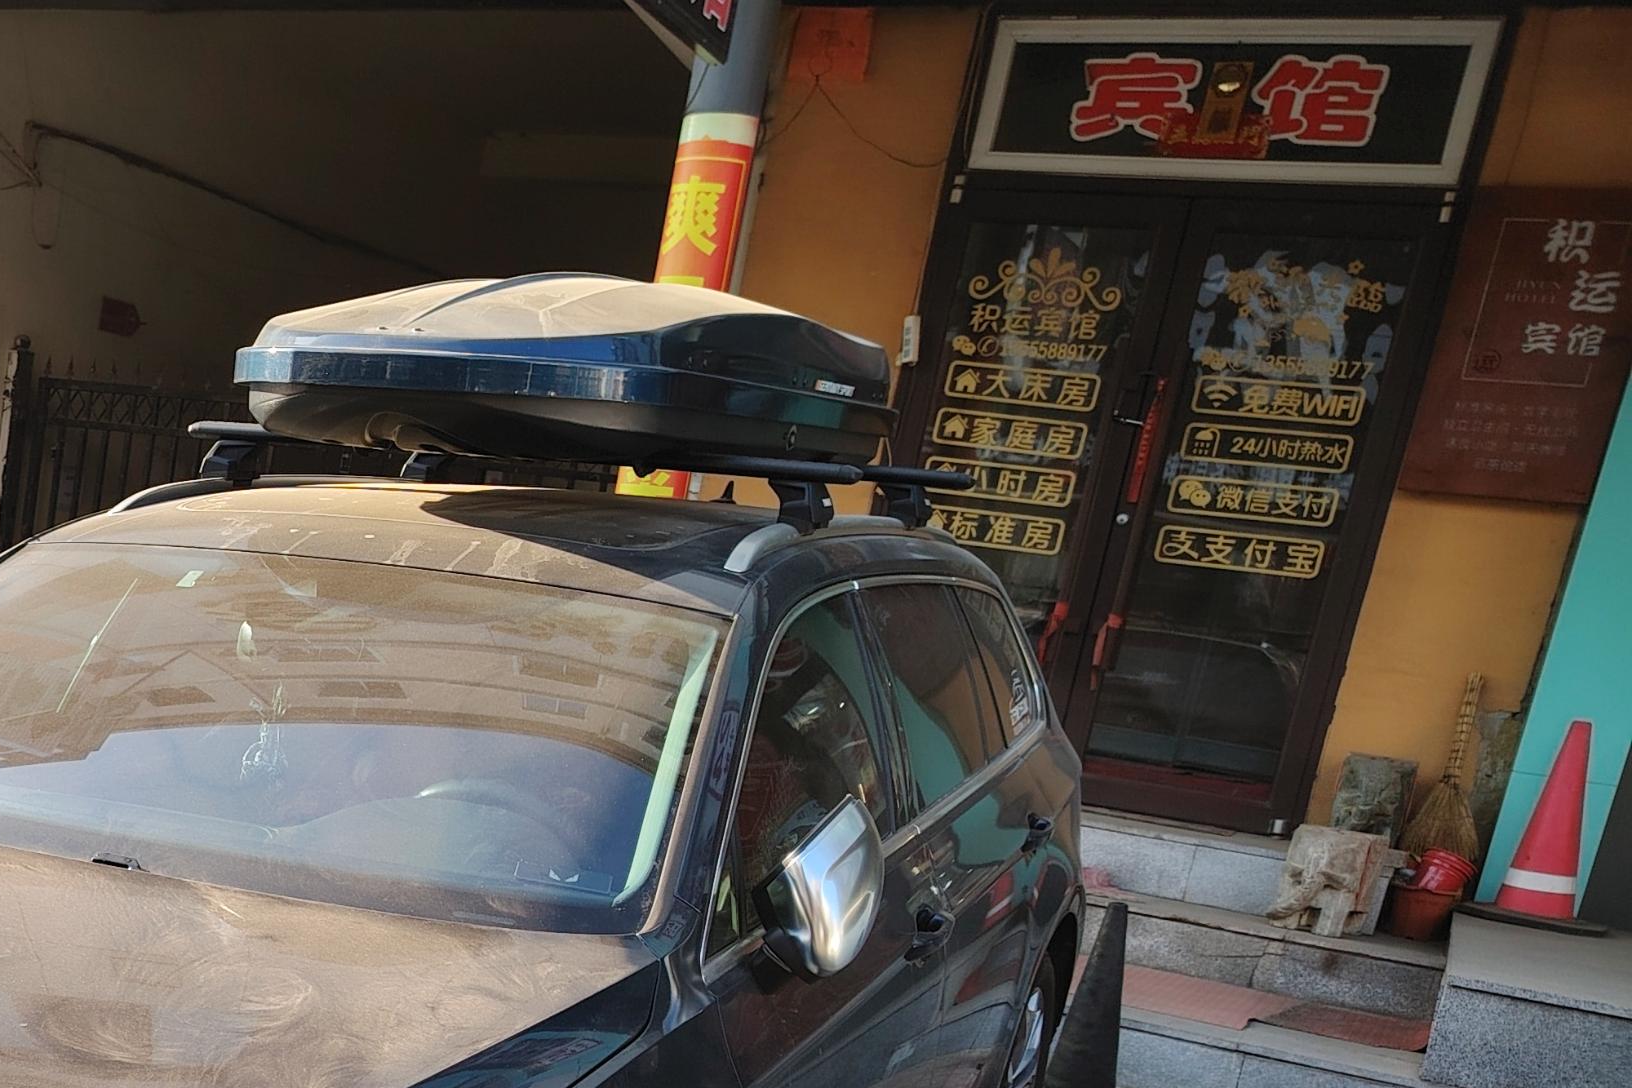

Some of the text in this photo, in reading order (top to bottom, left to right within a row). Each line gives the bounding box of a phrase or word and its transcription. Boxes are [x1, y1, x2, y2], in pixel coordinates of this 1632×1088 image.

[1070, 52, 1391, 147] 宾馆
[662, 175, 726, 257] 爽
[969, 302, 1101, 340] 积运宾馆
[1521, 321, 1607, 357] 宾馆
[981, 369, 1091, 407] 大床房
[969, 416, 1077, 455] 家庭房
[1229, 436, 1348, 465] 24小时热水
[964, 465, 1066, 503] 小时房
[1215, 483, 1331, 519] 微信支付
[948, 510, 1054, 549] 标准房
